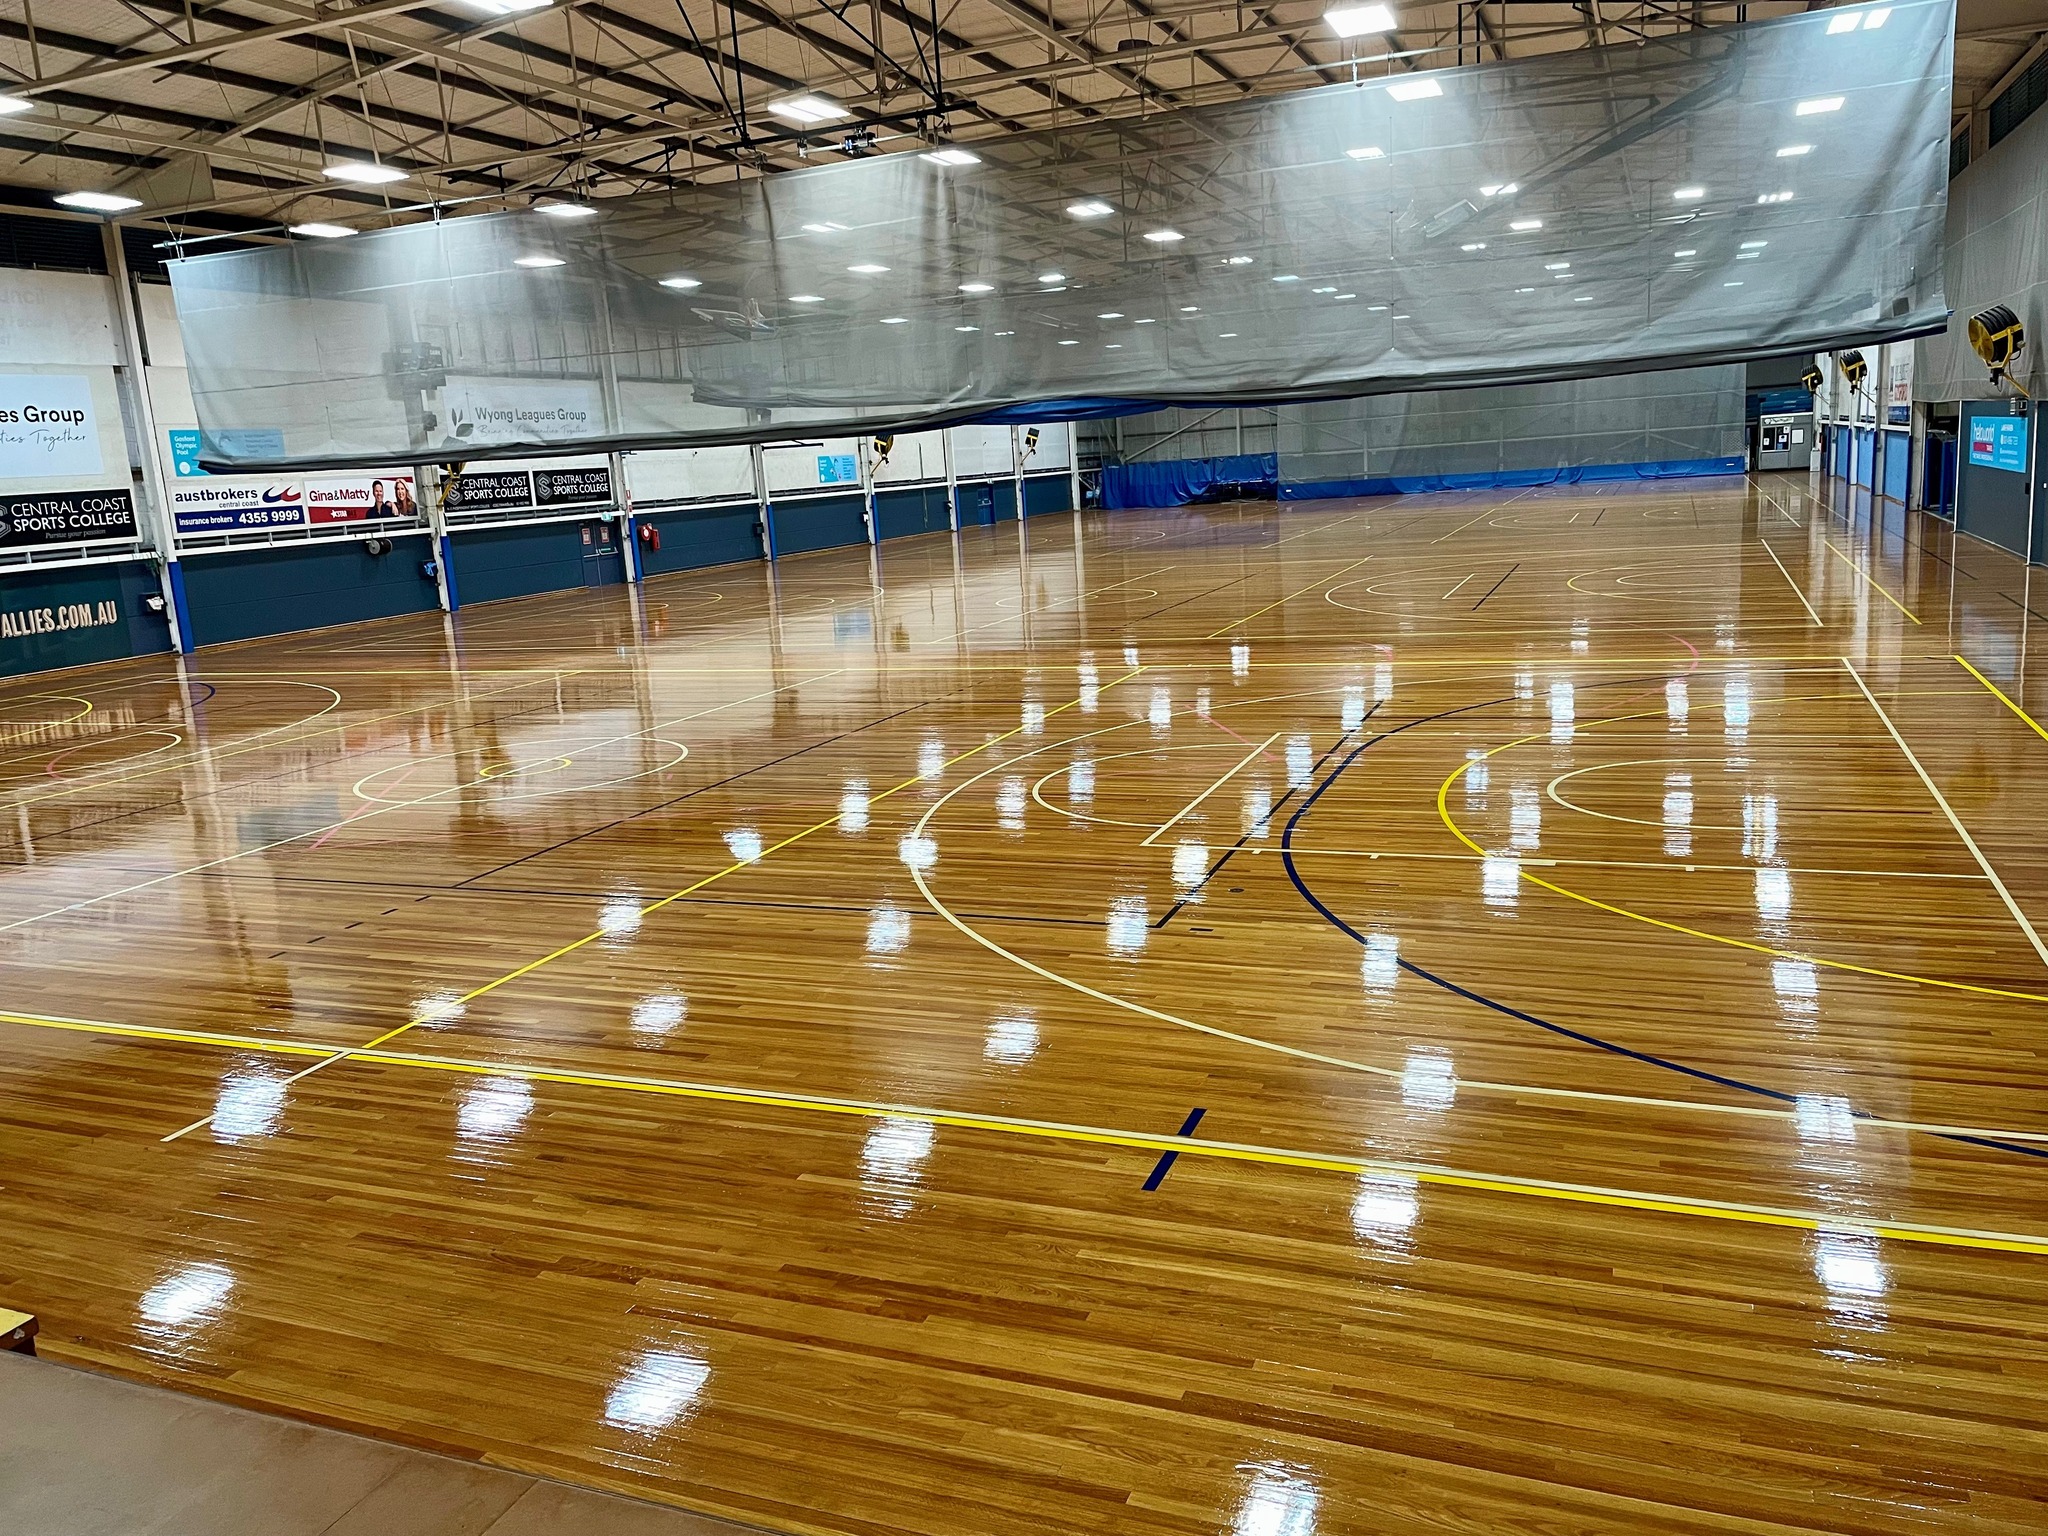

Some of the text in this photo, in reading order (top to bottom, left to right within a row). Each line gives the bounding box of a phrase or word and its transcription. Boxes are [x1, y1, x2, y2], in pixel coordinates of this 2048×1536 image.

[0, 405, 85, 426] es Group
[475, 407, 587, 423] Wyong Leagues Group
[29, 427, 87, 452] Together
[463, 476, 527, 489] CENTRAL COAST
[552, 472, 607, 485] CENTRAL COAST
[175, 488, 258, 502] austbrokers
[464, 487, 529, 500] SPORTS COLLEGE
[553, 483, 609, 495] SPORTS COLLEGE
[11, 497, 127, 517] CENTRAL COAST
[219, 501, 241, 509] central
[13, 511, 131, 532] SPORTS COLLEGE
[179, 515, 233, 526] insurance brokers
[239, 509, 300, 524] 4355 9999
[83, 529, 106, 537] passion
[1, 600, 118, 639] ALLIES.COM.AU
